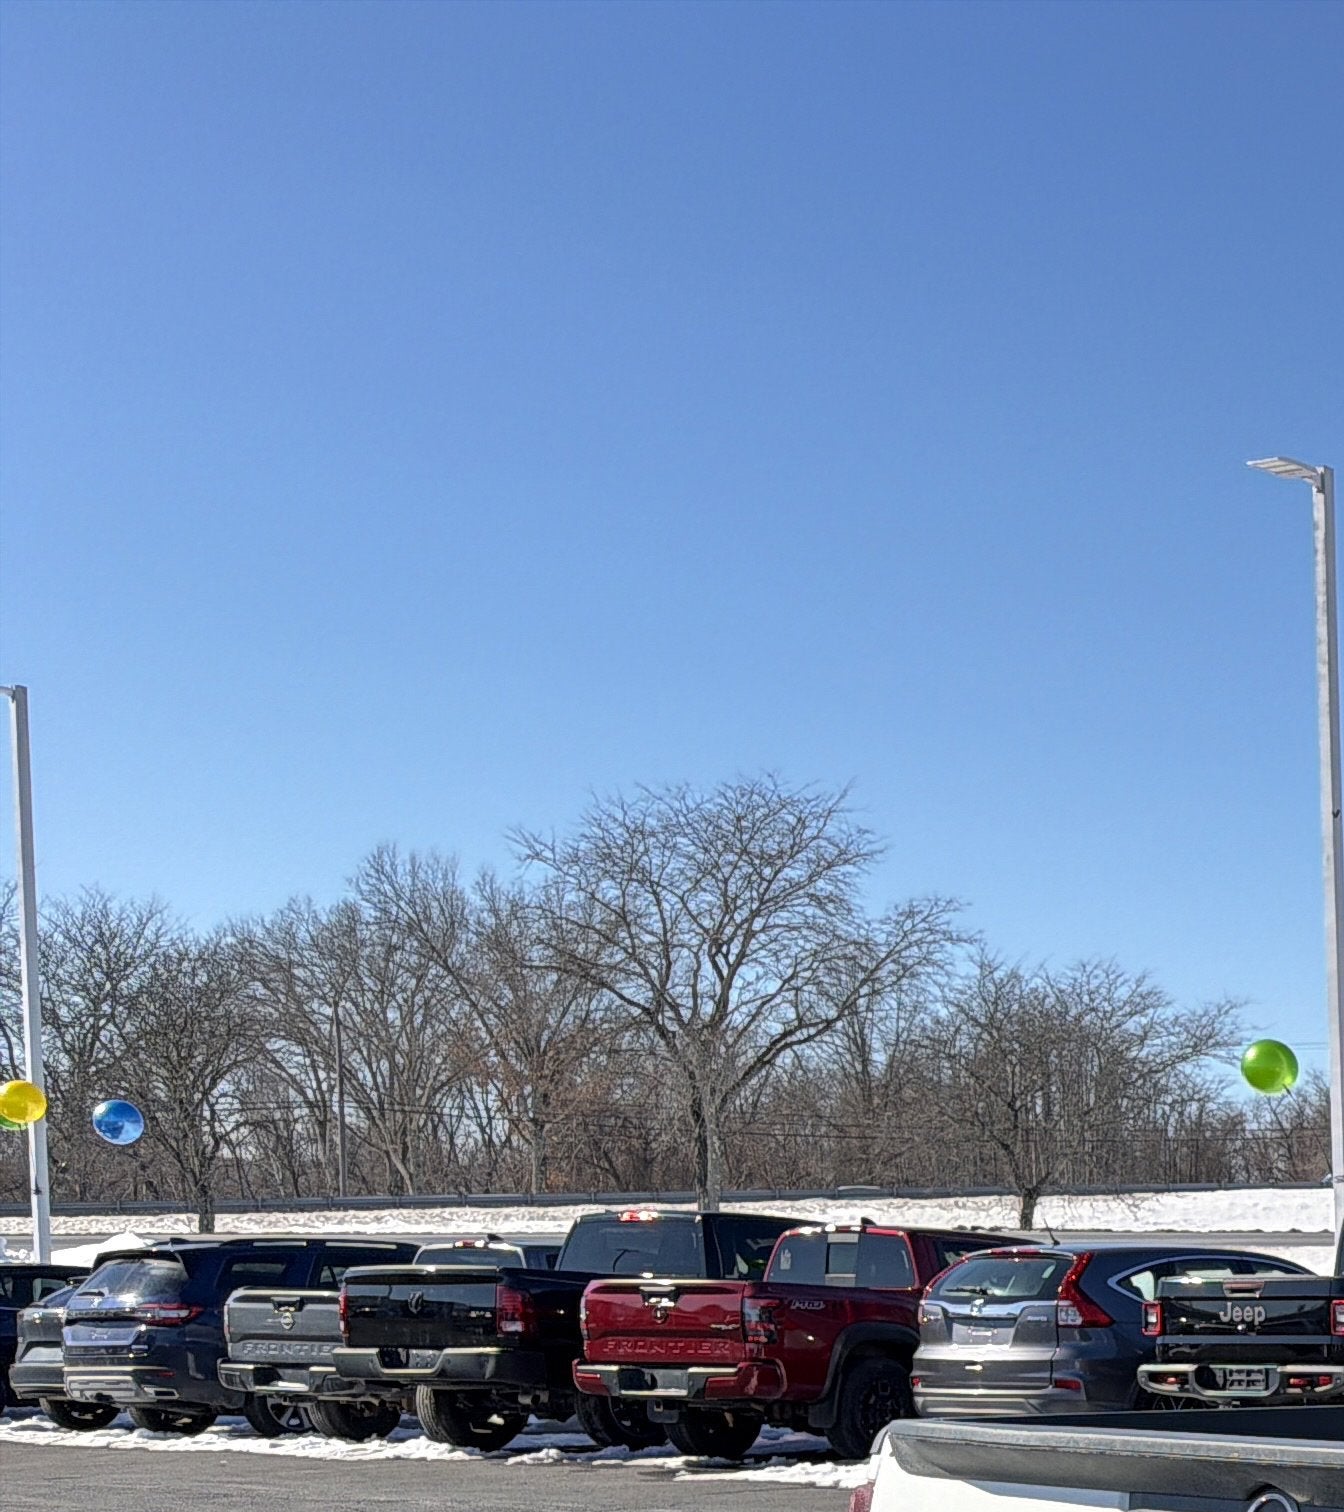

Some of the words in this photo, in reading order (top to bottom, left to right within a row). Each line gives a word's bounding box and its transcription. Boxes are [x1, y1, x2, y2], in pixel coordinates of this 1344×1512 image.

[1218, 1301, 1266, 1325] Jeep
[243, 1343, 332, 1356] FRONTIE
[603, 1340, 730, 1355] FRONTIER
